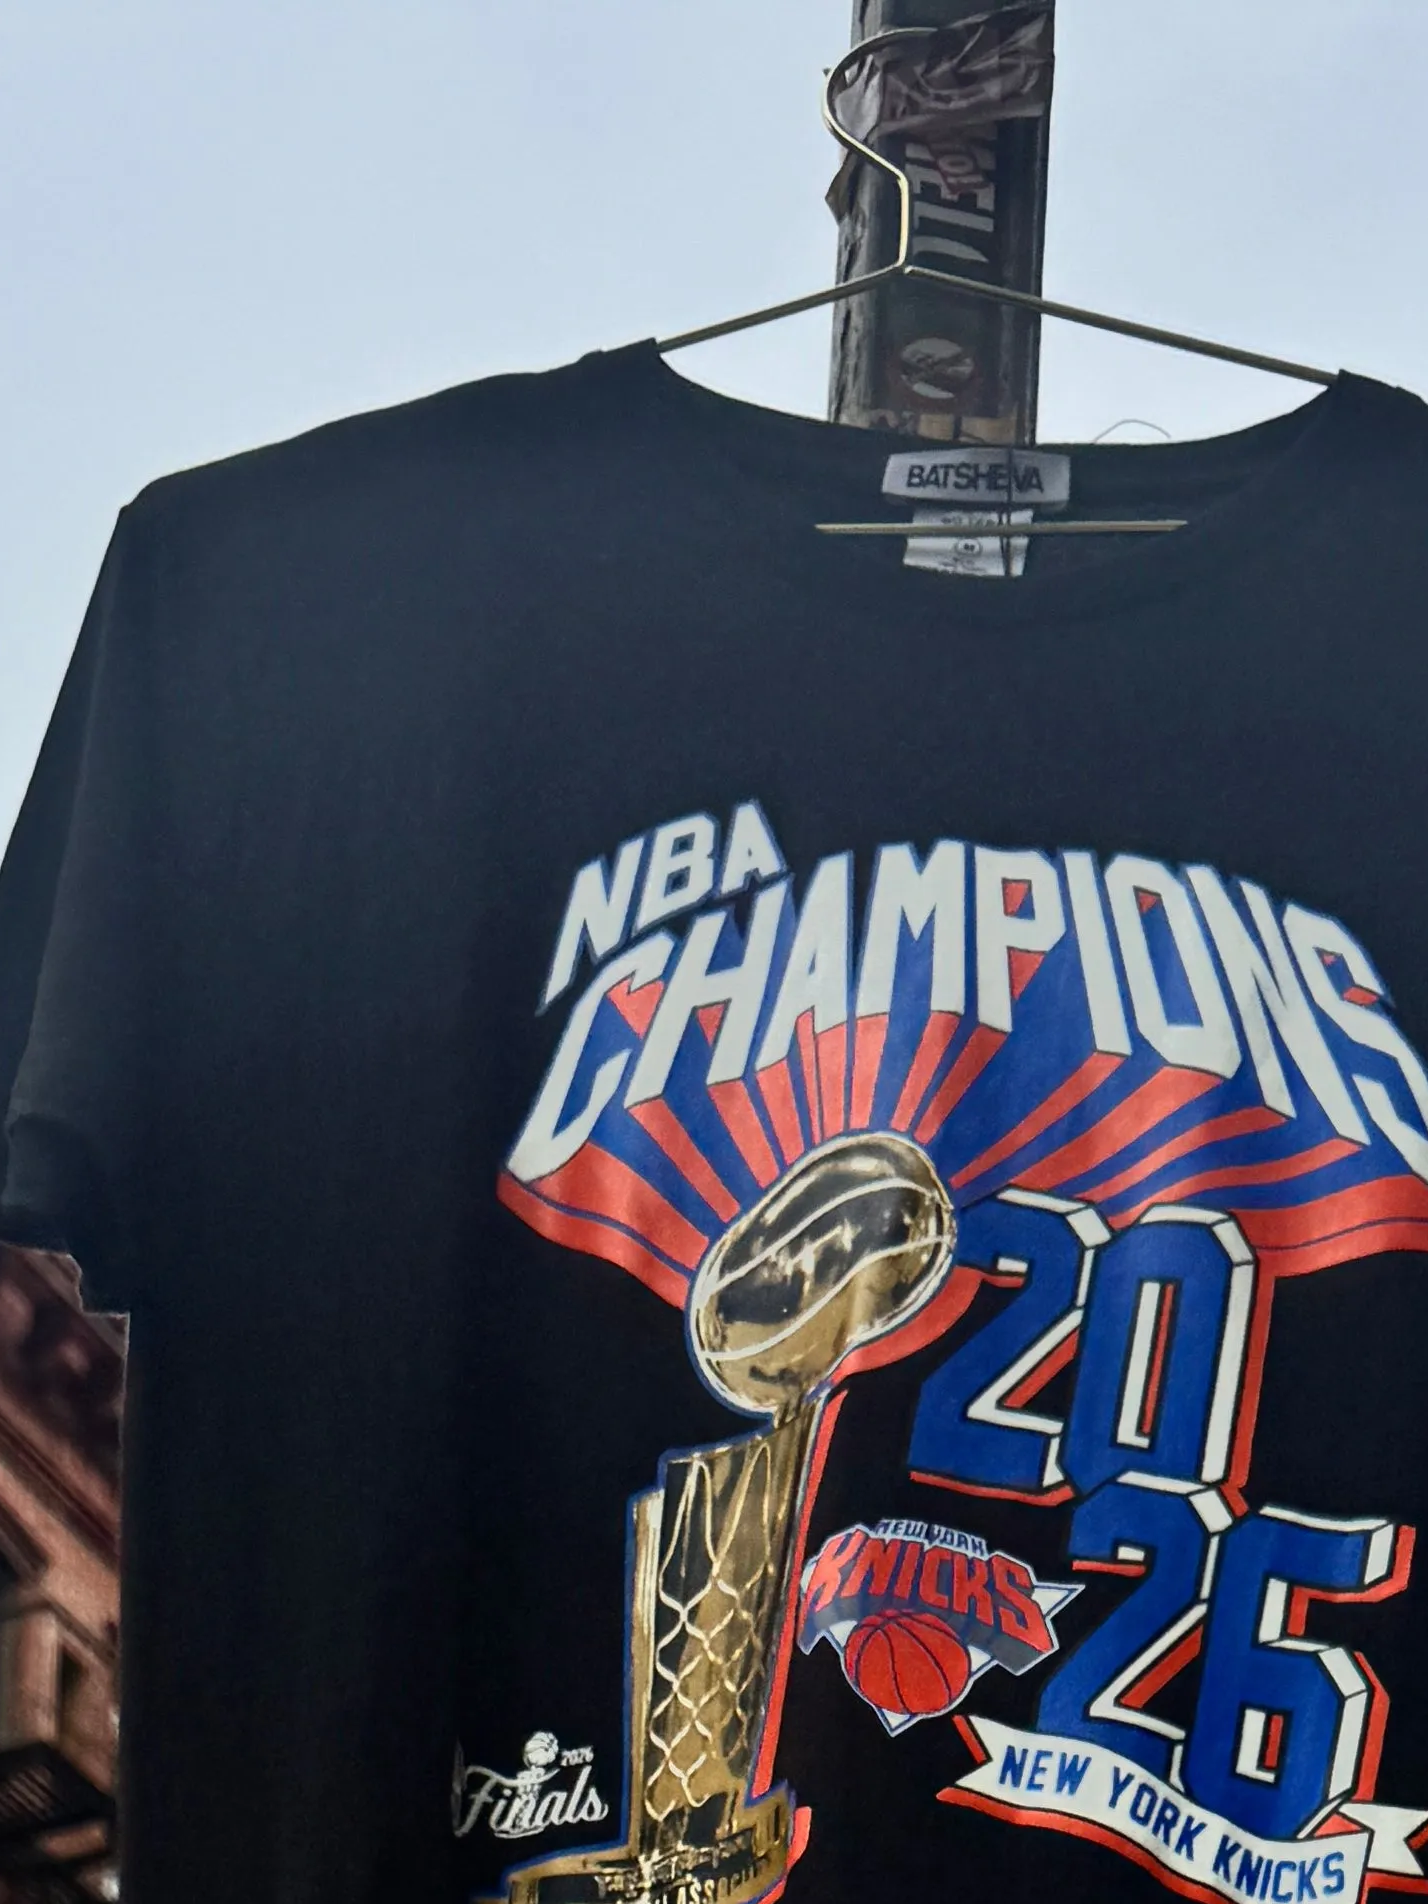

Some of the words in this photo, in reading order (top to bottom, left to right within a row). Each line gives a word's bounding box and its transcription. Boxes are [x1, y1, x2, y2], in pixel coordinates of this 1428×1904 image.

[906, 461, 1045, 494] BATSHEVA
[544, 801, 784, 1006] NBA
[907, 1188, 1257, 1498] 20
[798, 1528, 1053, 1654] KNICKS
[1035, 1470, 1395, 1842] 26
[453, 1764, 610, 1838] Finals
[998, 1745, 1091, 1797] NEW
[1107, 1765, 1208, 1862] YORK
[1212, 1832, 1346, 1904] KNICKS
